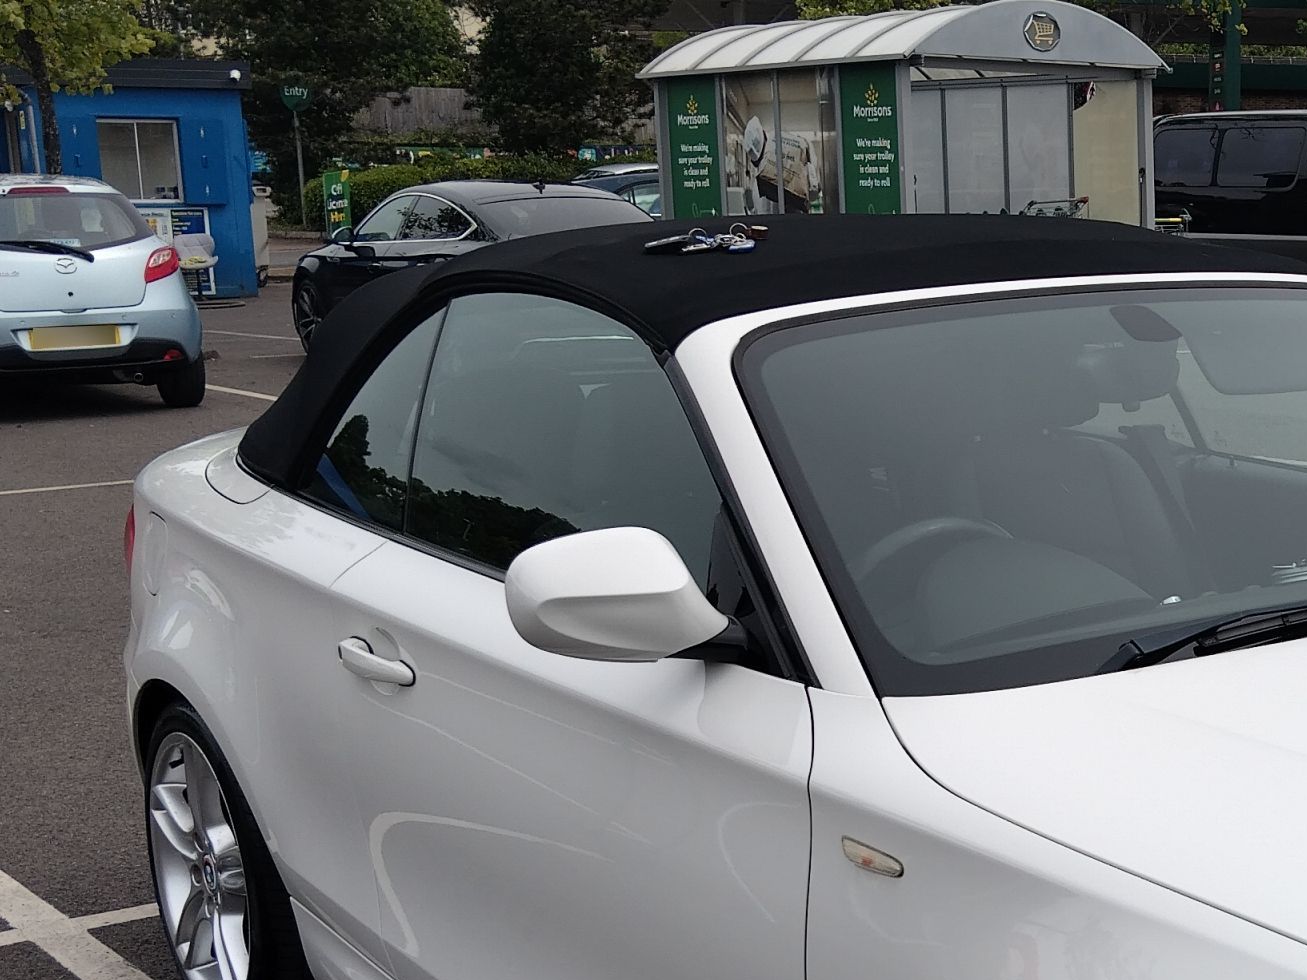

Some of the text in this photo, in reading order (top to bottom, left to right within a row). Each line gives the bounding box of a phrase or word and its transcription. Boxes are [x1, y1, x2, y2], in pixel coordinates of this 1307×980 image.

[284, 86, 308, 99] Entry
[854, 104, 892, 117] Morrisons
[677, 114, 709, 126] Morrisons
[693, 142, 709, 153] making
[856, 137, 891, 149] We're making
[688, 157, 698, 165] your
[698, 154, 713, 165] trolley
[853, 151, 895, 163] sure your trolley
[688, 166, 699, 176] clean
[699, 166, 709, 176] and
[859, 163, 889, 174] is clean and
[683, 178, 710, 190] ready to roll
[859, 177, 891, 189] ready to roll
